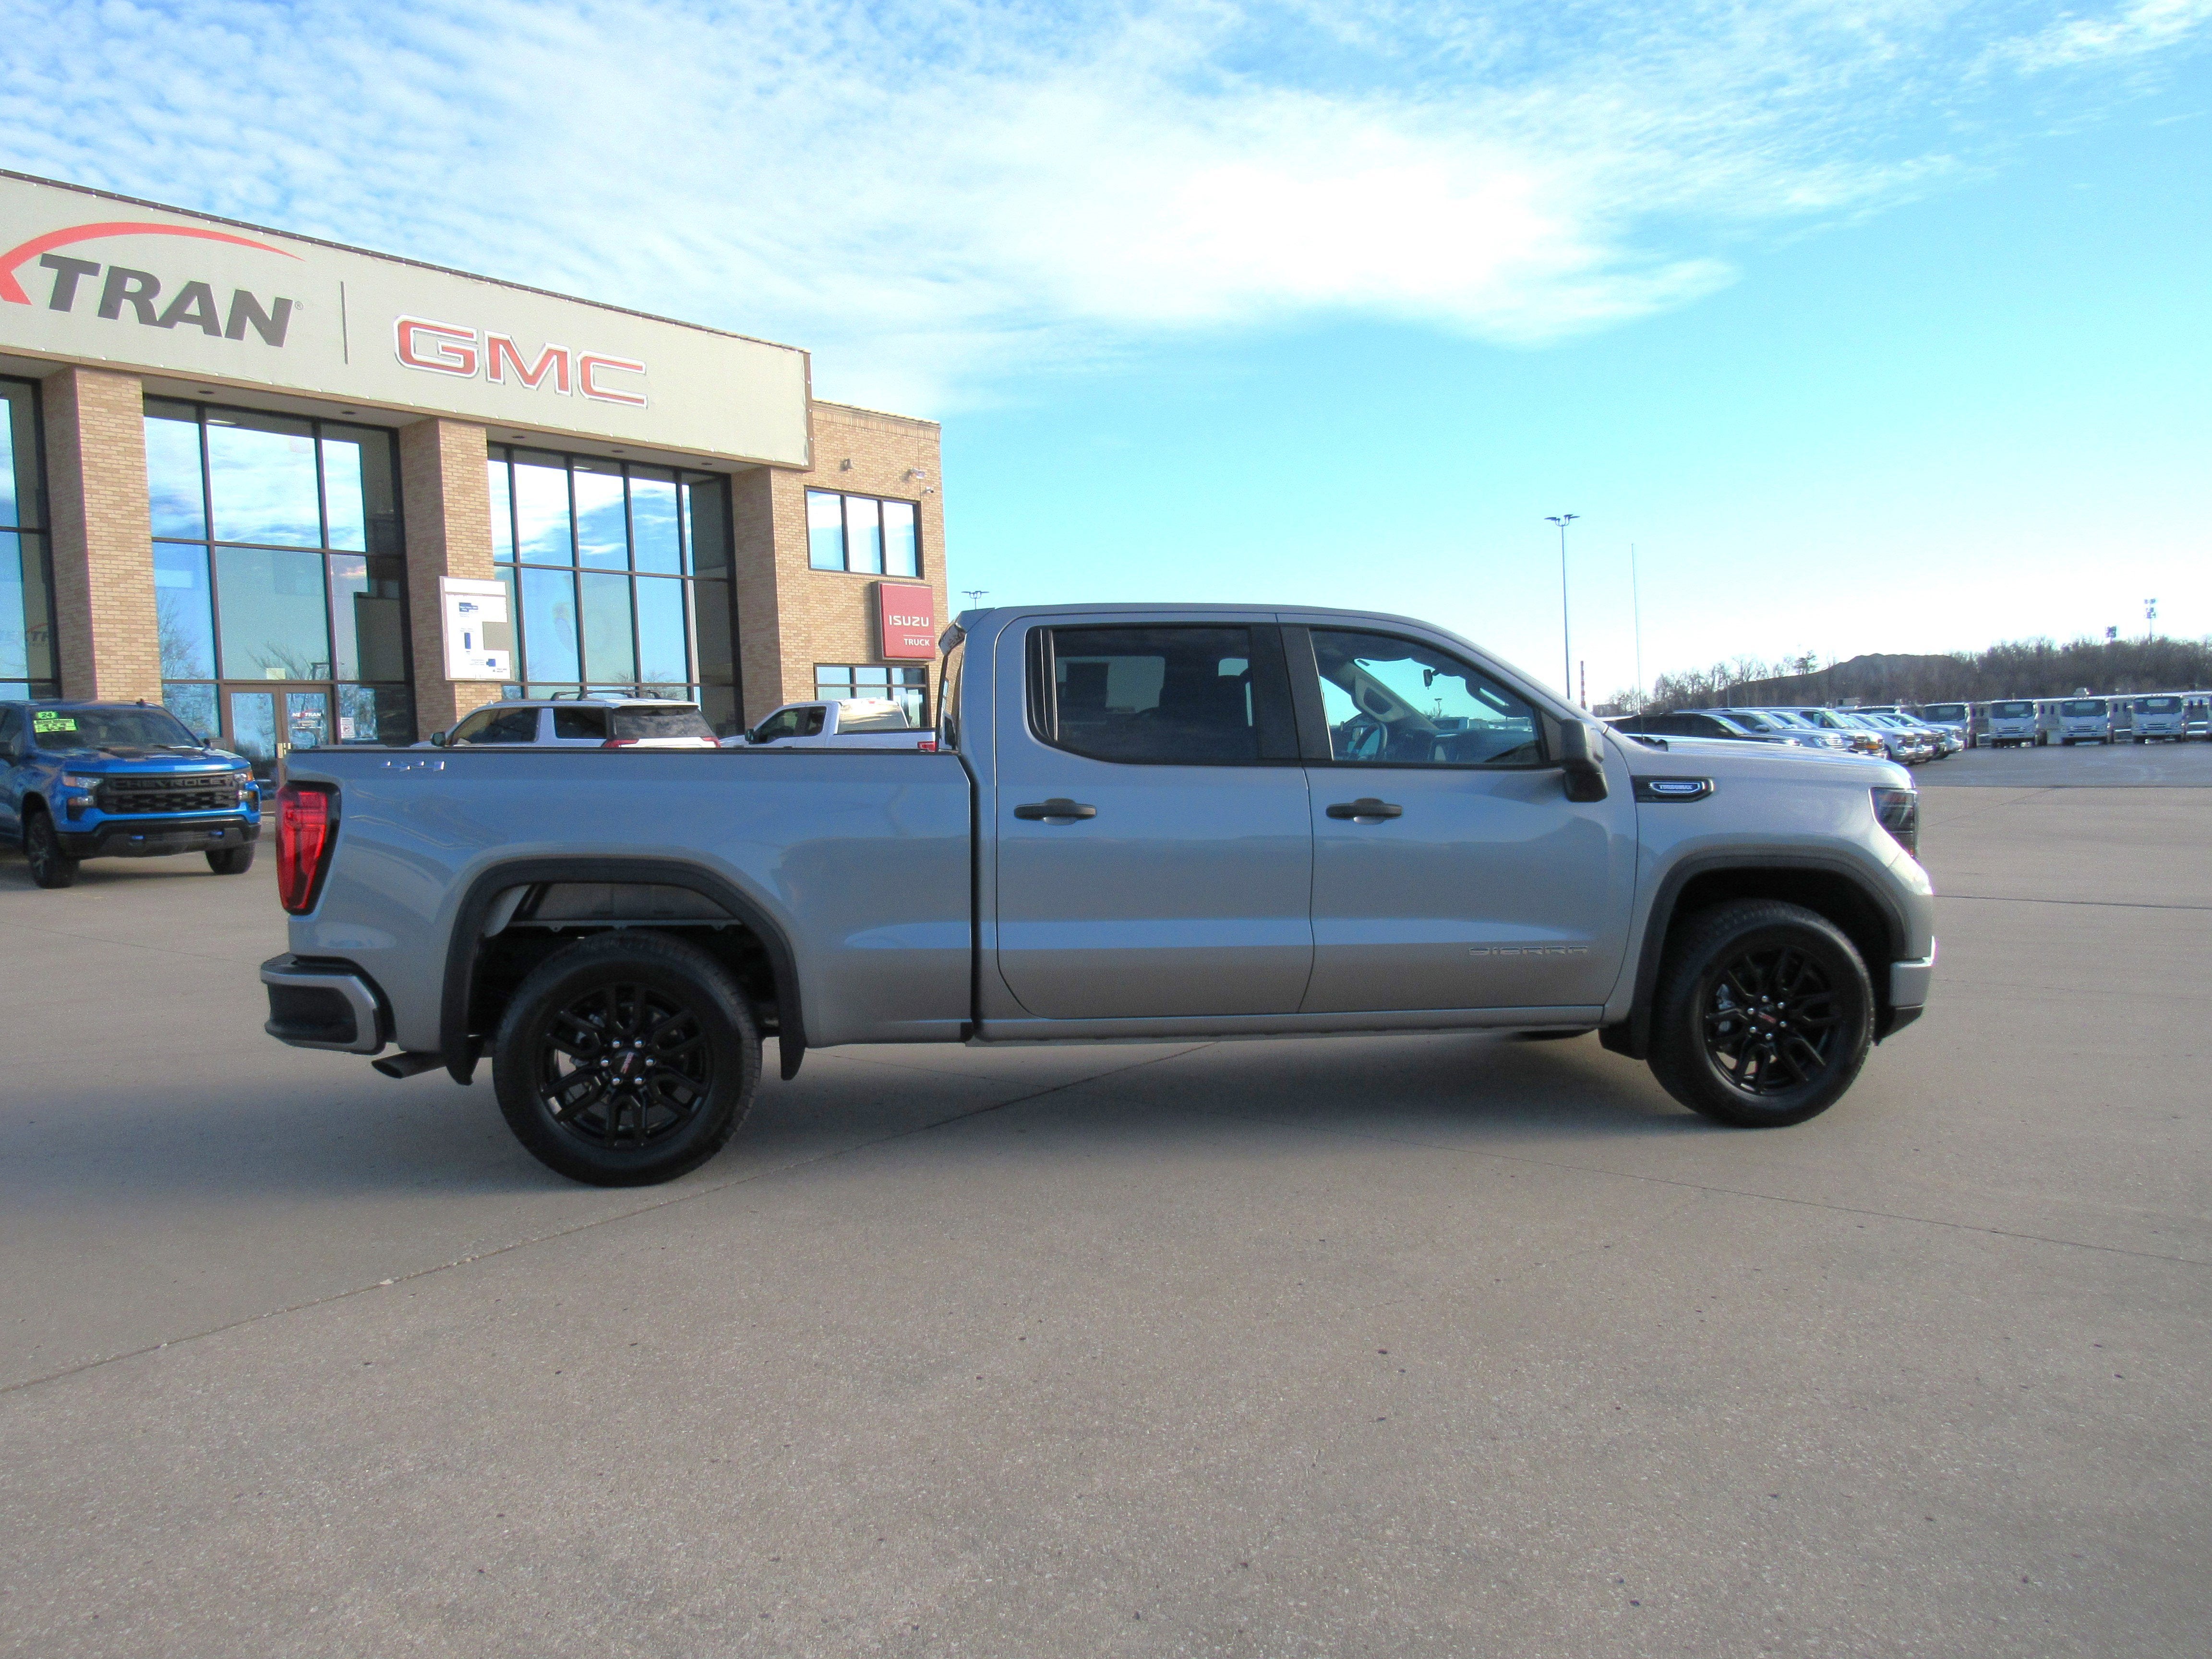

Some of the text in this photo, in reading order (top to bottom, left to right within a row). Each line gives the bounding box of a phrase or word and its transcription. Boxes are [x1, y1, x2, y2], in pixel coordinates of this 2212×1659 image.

[393, 314, 648, 409] GMC
[889, 615, 929, 626] ISUZU
[1469, 946, 1588, 955] SIERRA
